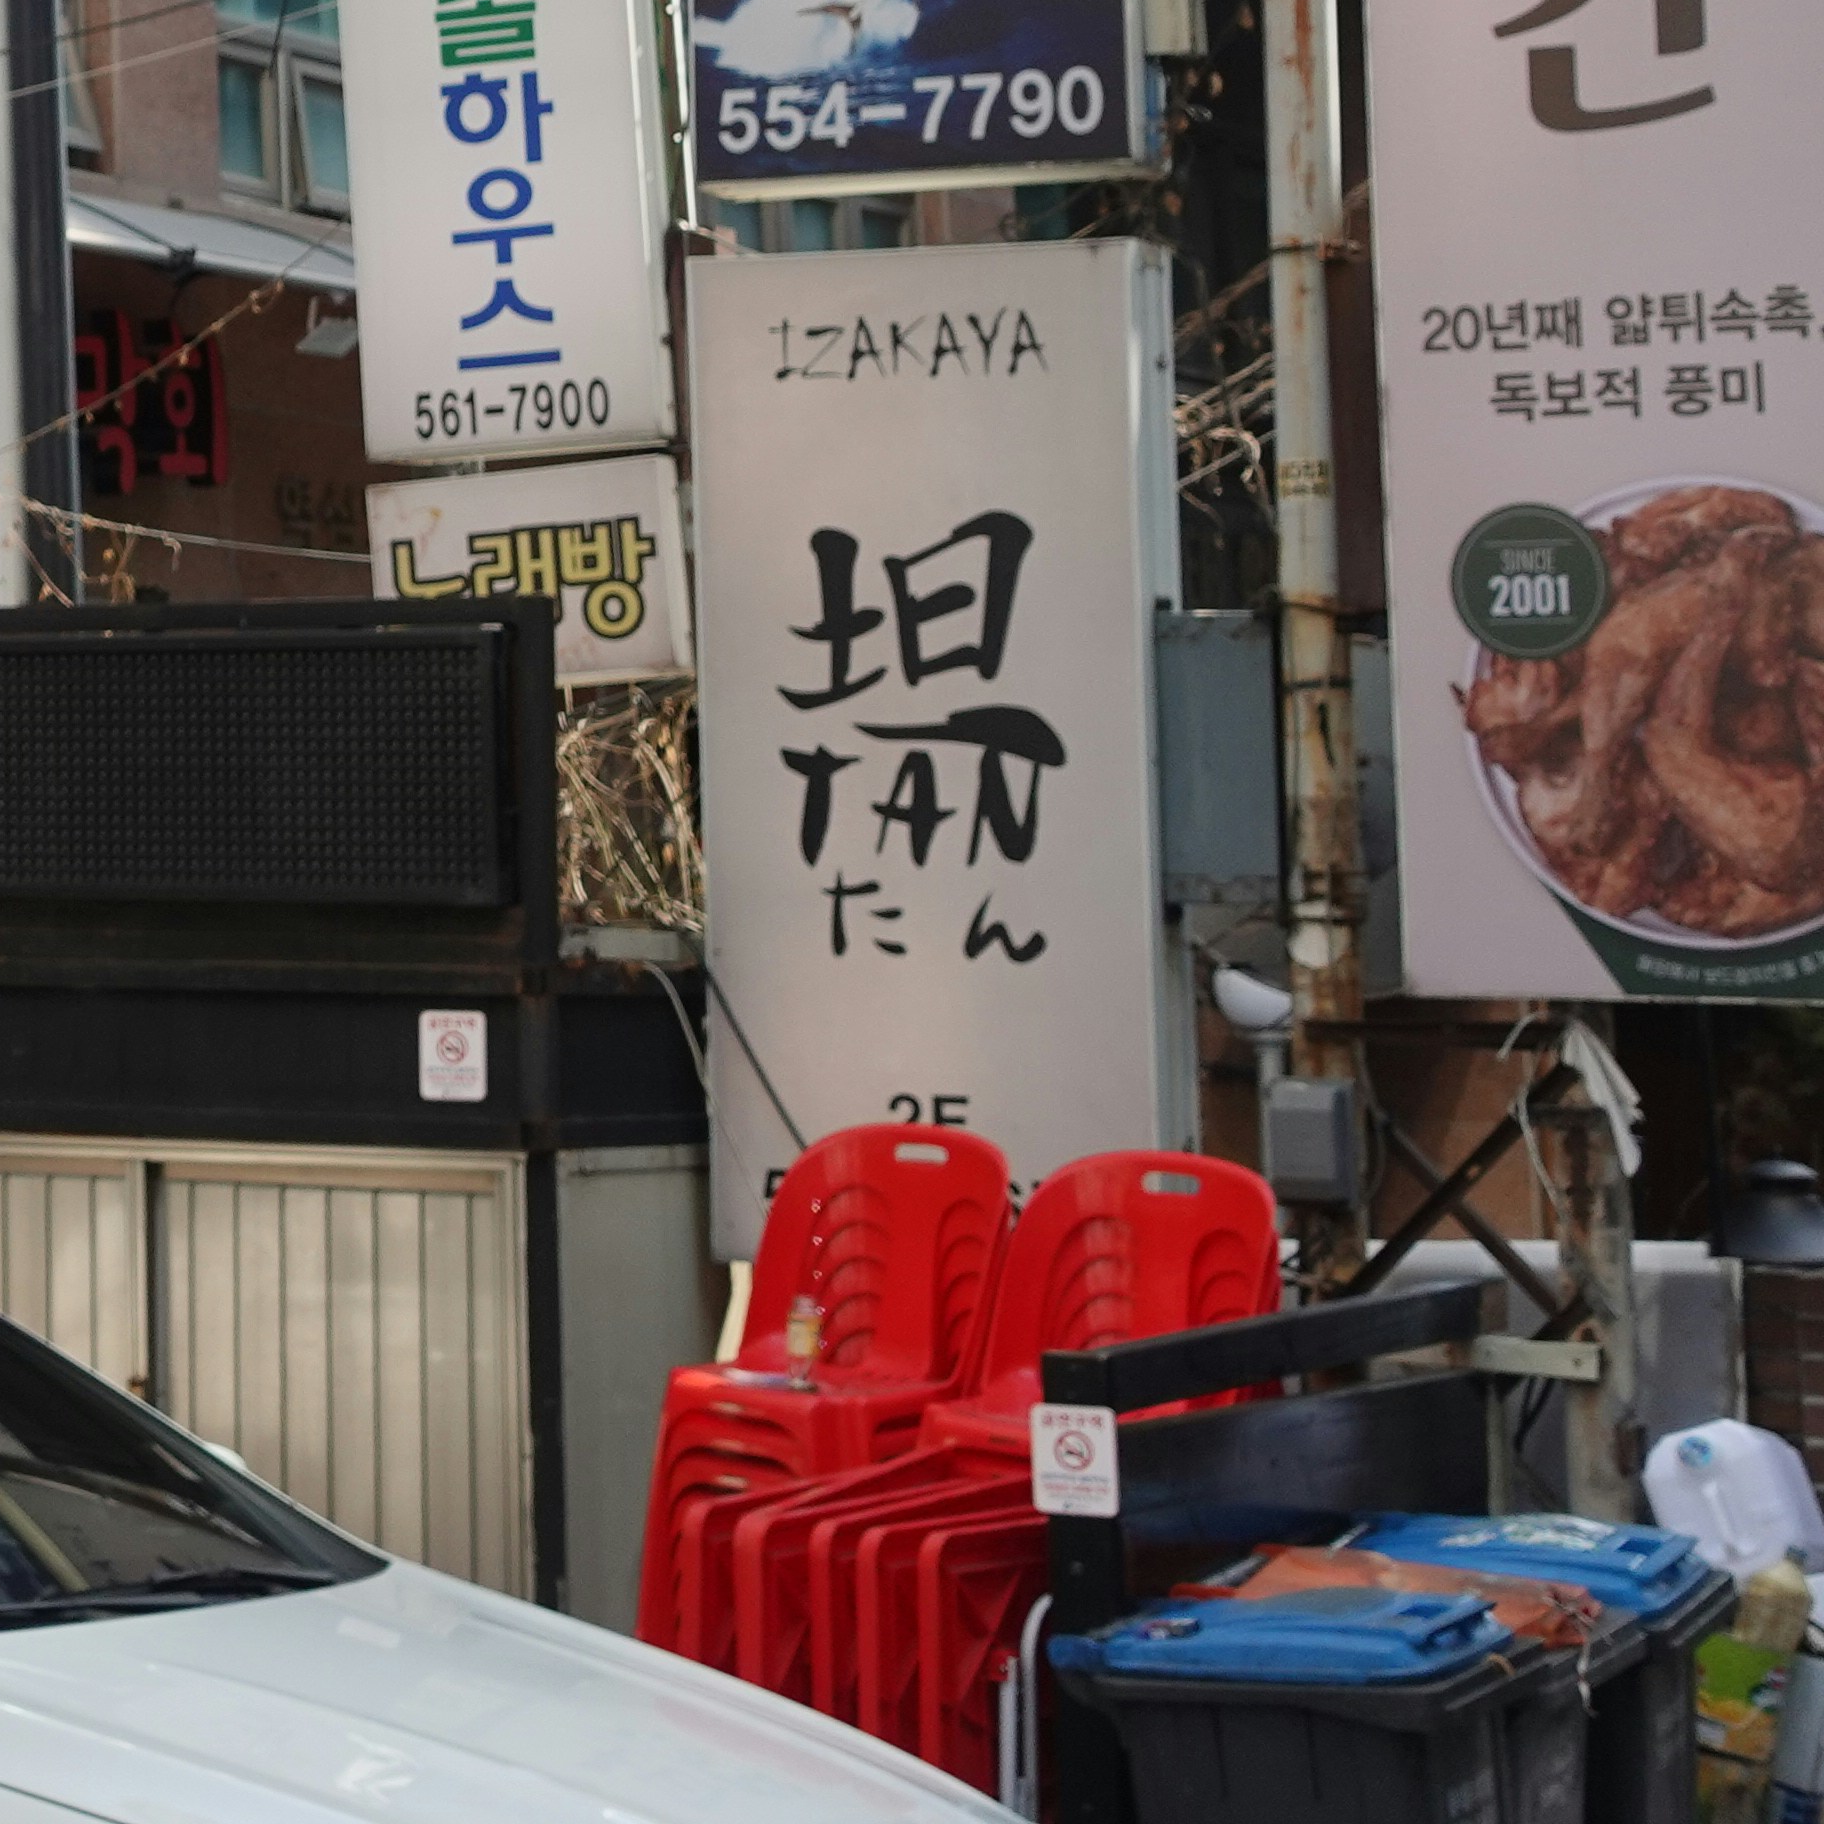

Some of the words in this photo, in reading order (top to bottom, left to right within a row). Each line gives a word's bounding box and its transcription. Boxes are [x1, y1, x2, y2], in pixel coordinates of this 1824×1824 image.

[717, 65, 1104, 155] 554-7790
[768, 305, 1050, 382] IZAKAYA
[1422, 295, 1583, 353] 20년째
[413, 378, 611, 442] 561-7900
[1489, 365, 1643, 423] 독보적
[1663, 359, 1766, 416] 풍미
[1499, 547, 1556, 572] SINCE
[1487, 573, 1572, 618] 2001
[778, 742, 1042, 868] TAN
[822, 870, 1047, 964] たん
